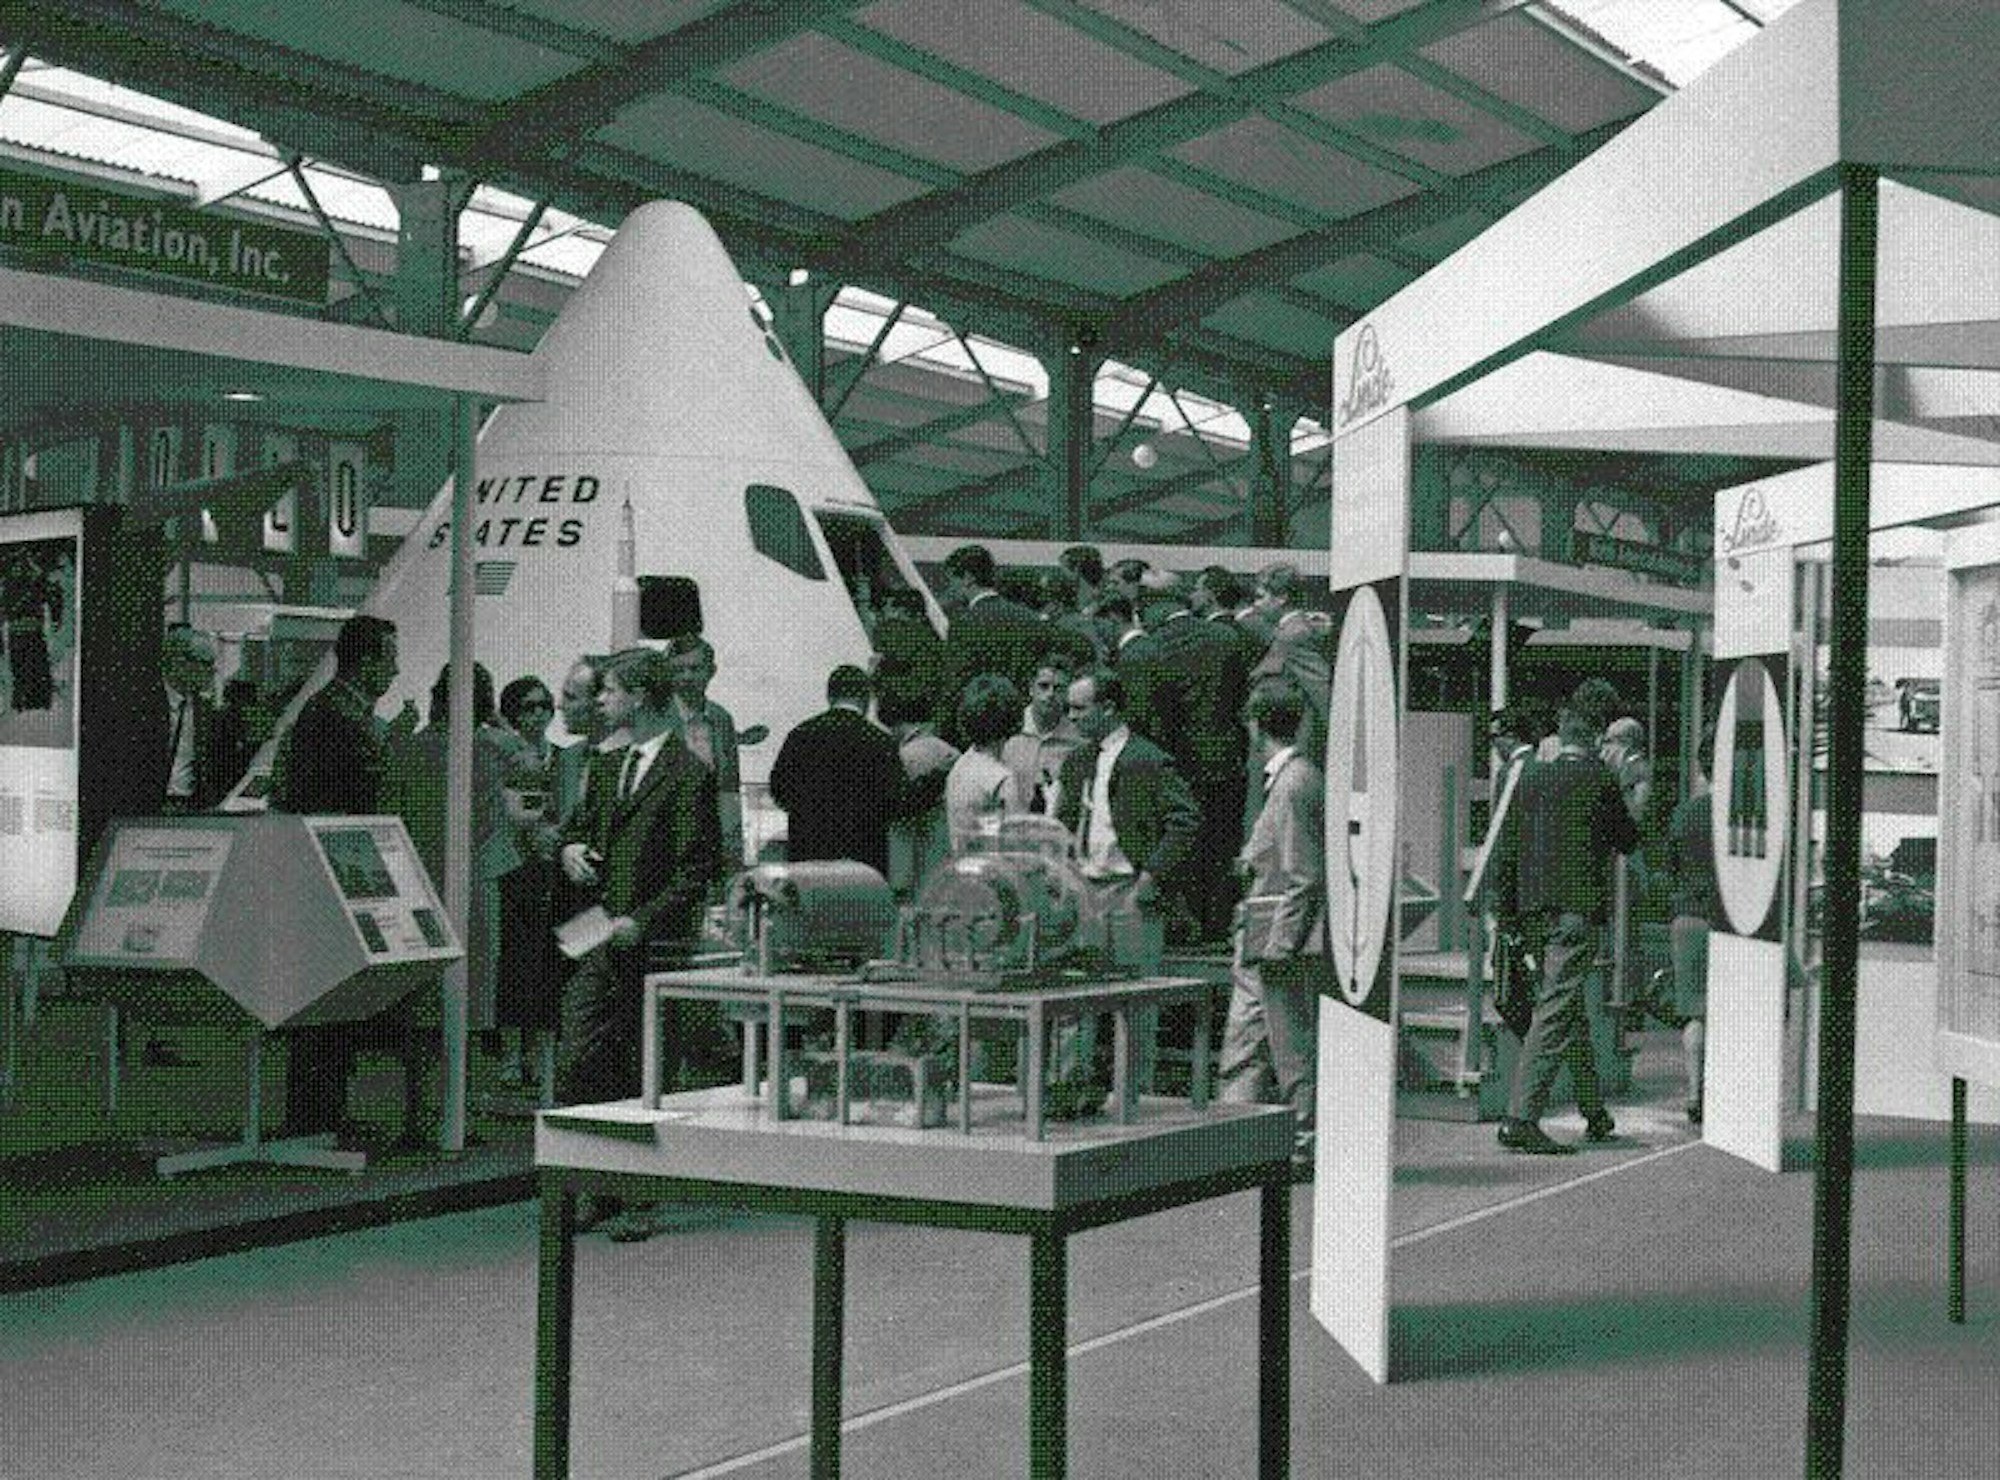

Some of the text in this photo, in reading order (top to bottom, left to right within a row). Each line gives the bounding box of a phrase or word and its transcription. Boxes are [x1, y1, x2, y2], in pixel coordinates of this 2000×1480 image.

[42, 192, 219, 276] Aviation,
[230, 229, 290, 283] Inc.
[477, 474, 600, 504] NITED
[428, 518, 584, 550] SATES
